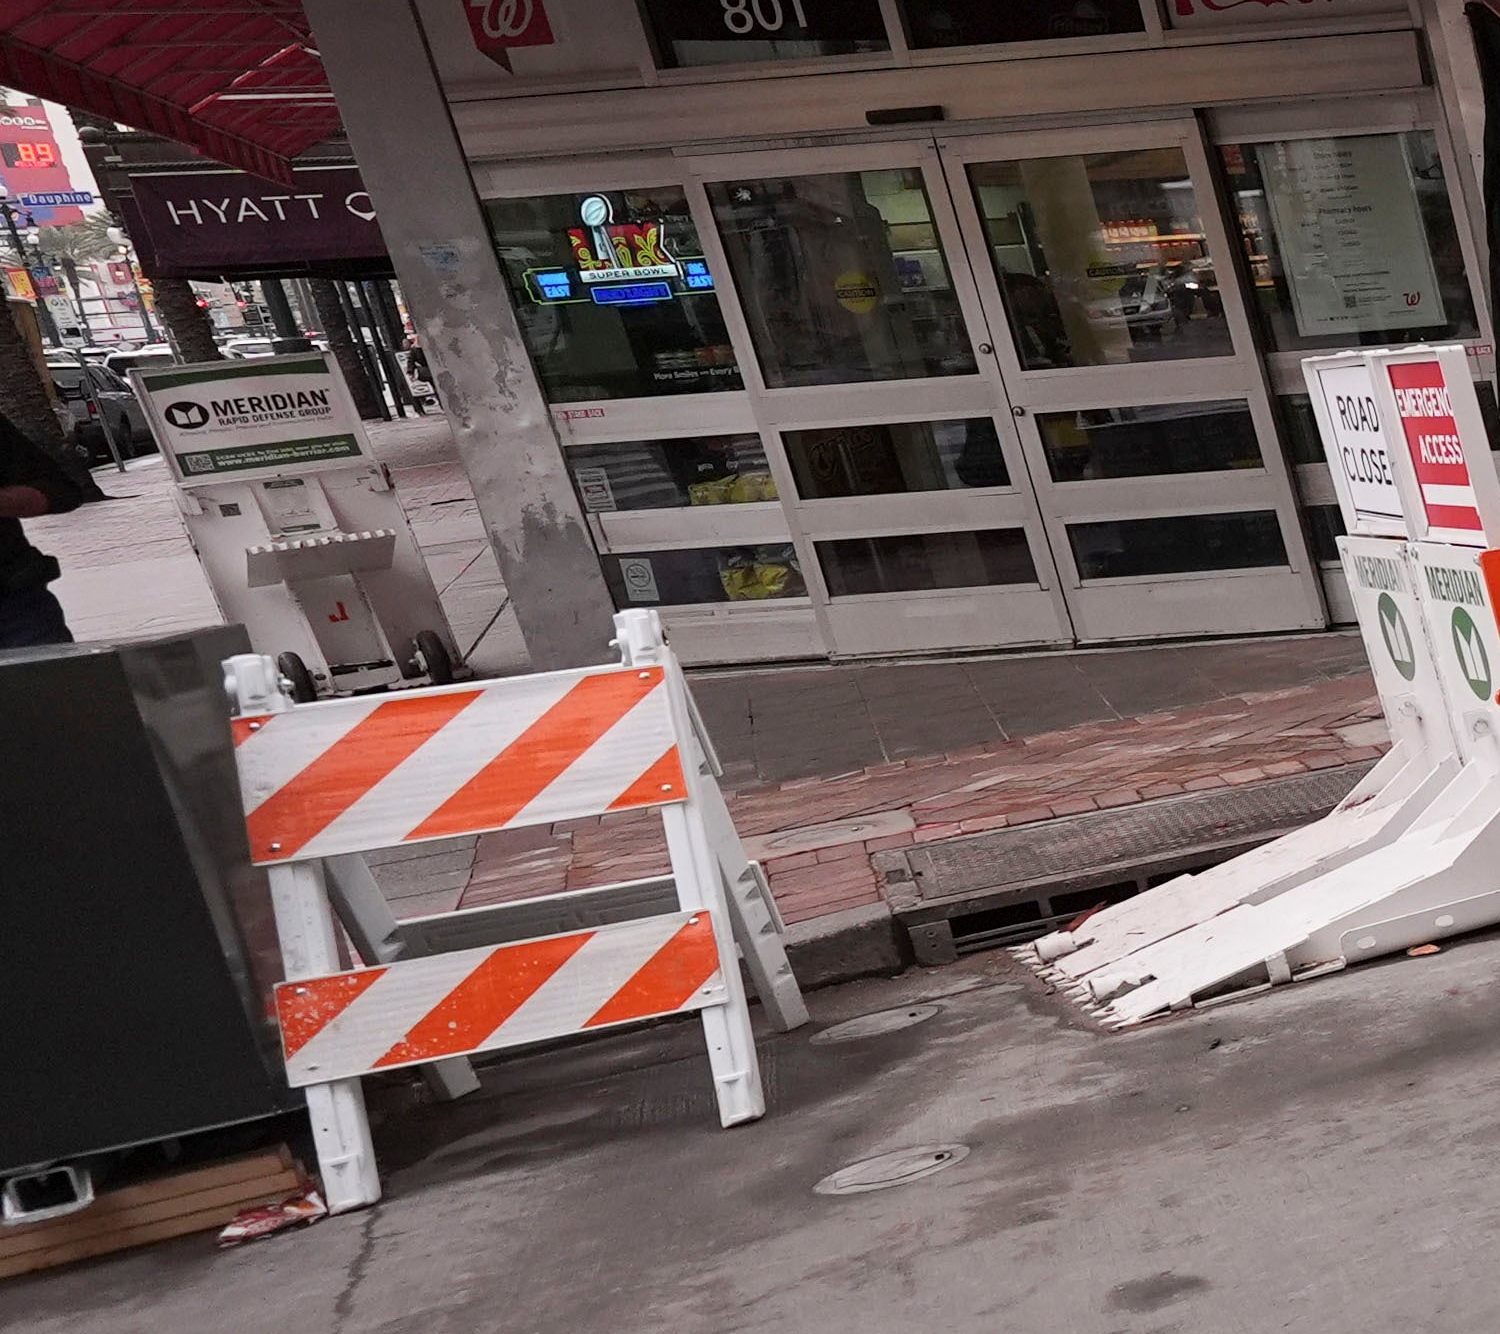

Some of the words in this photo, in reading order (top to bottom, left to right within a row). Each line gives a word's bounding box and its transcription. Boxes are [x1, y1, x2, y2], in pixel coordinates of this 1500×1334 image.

[27, 191, 92, 205] Dauphine
[166, 193, 324, 226] HYATT
[588, 270, 630, 280] SUPER
[634, 268, 669, 277] BOWL
[211, 388, 330, 418] MERIDIAN
[218, 414, 250, 427] RAPID
[251, 410, 296, 424] DEFENSE
[298, 406, 332, 419] GROUP
[1335, 395, 1380, 433] ROAD
[1395, 387, 1455, 419] EMERGENC
[1418, 434, 1464, 465] ACCESS
[1343, 447, 1393, 486] CLOSE
[1353, 555, 1407, 594] MERIDIAN
[1424, 564, 1486, 607] MERIDIAN
